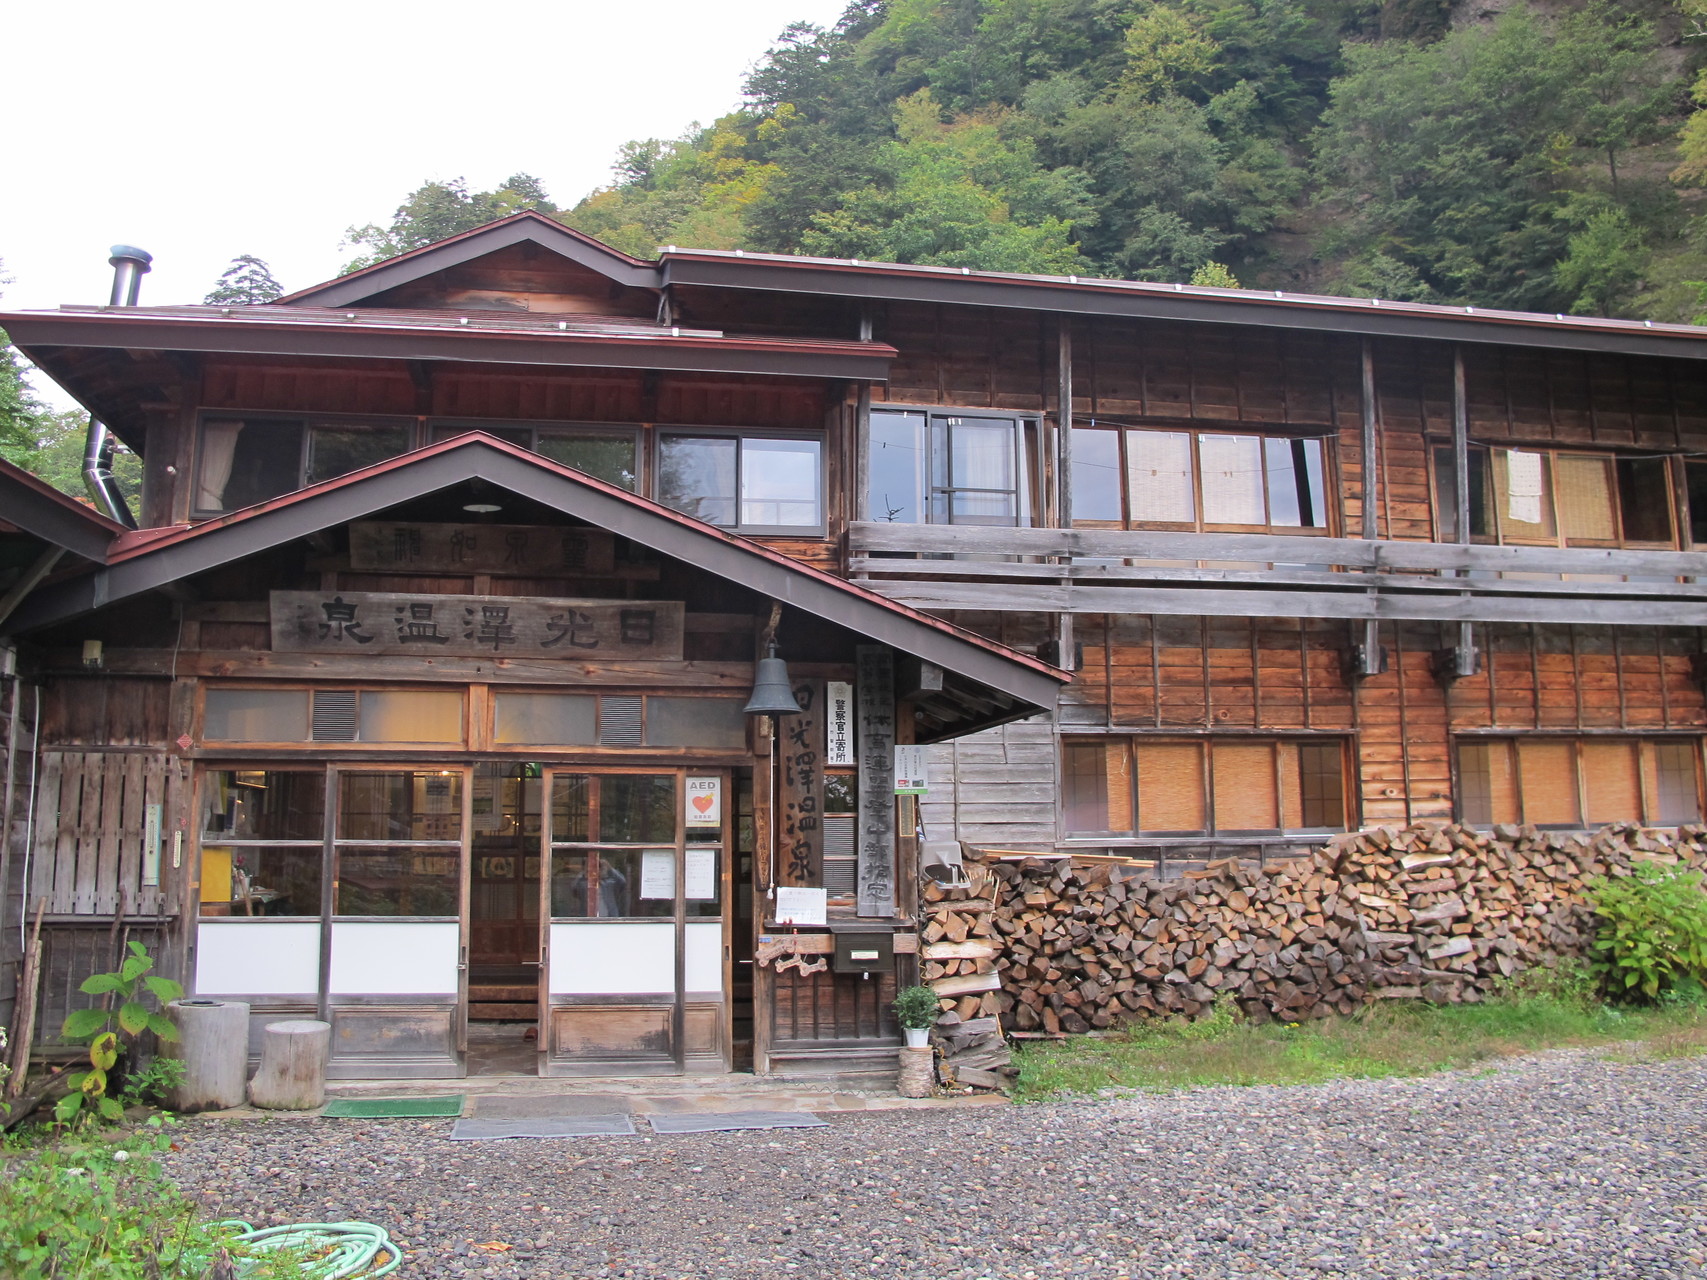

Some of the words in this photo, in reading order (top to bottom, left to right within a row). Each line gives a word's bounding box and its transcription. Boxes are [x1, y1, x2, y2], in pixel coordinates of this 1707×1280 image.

[834, 699, 847, 763] 警察官立寄所
[689, 781, 717, 790] AED
